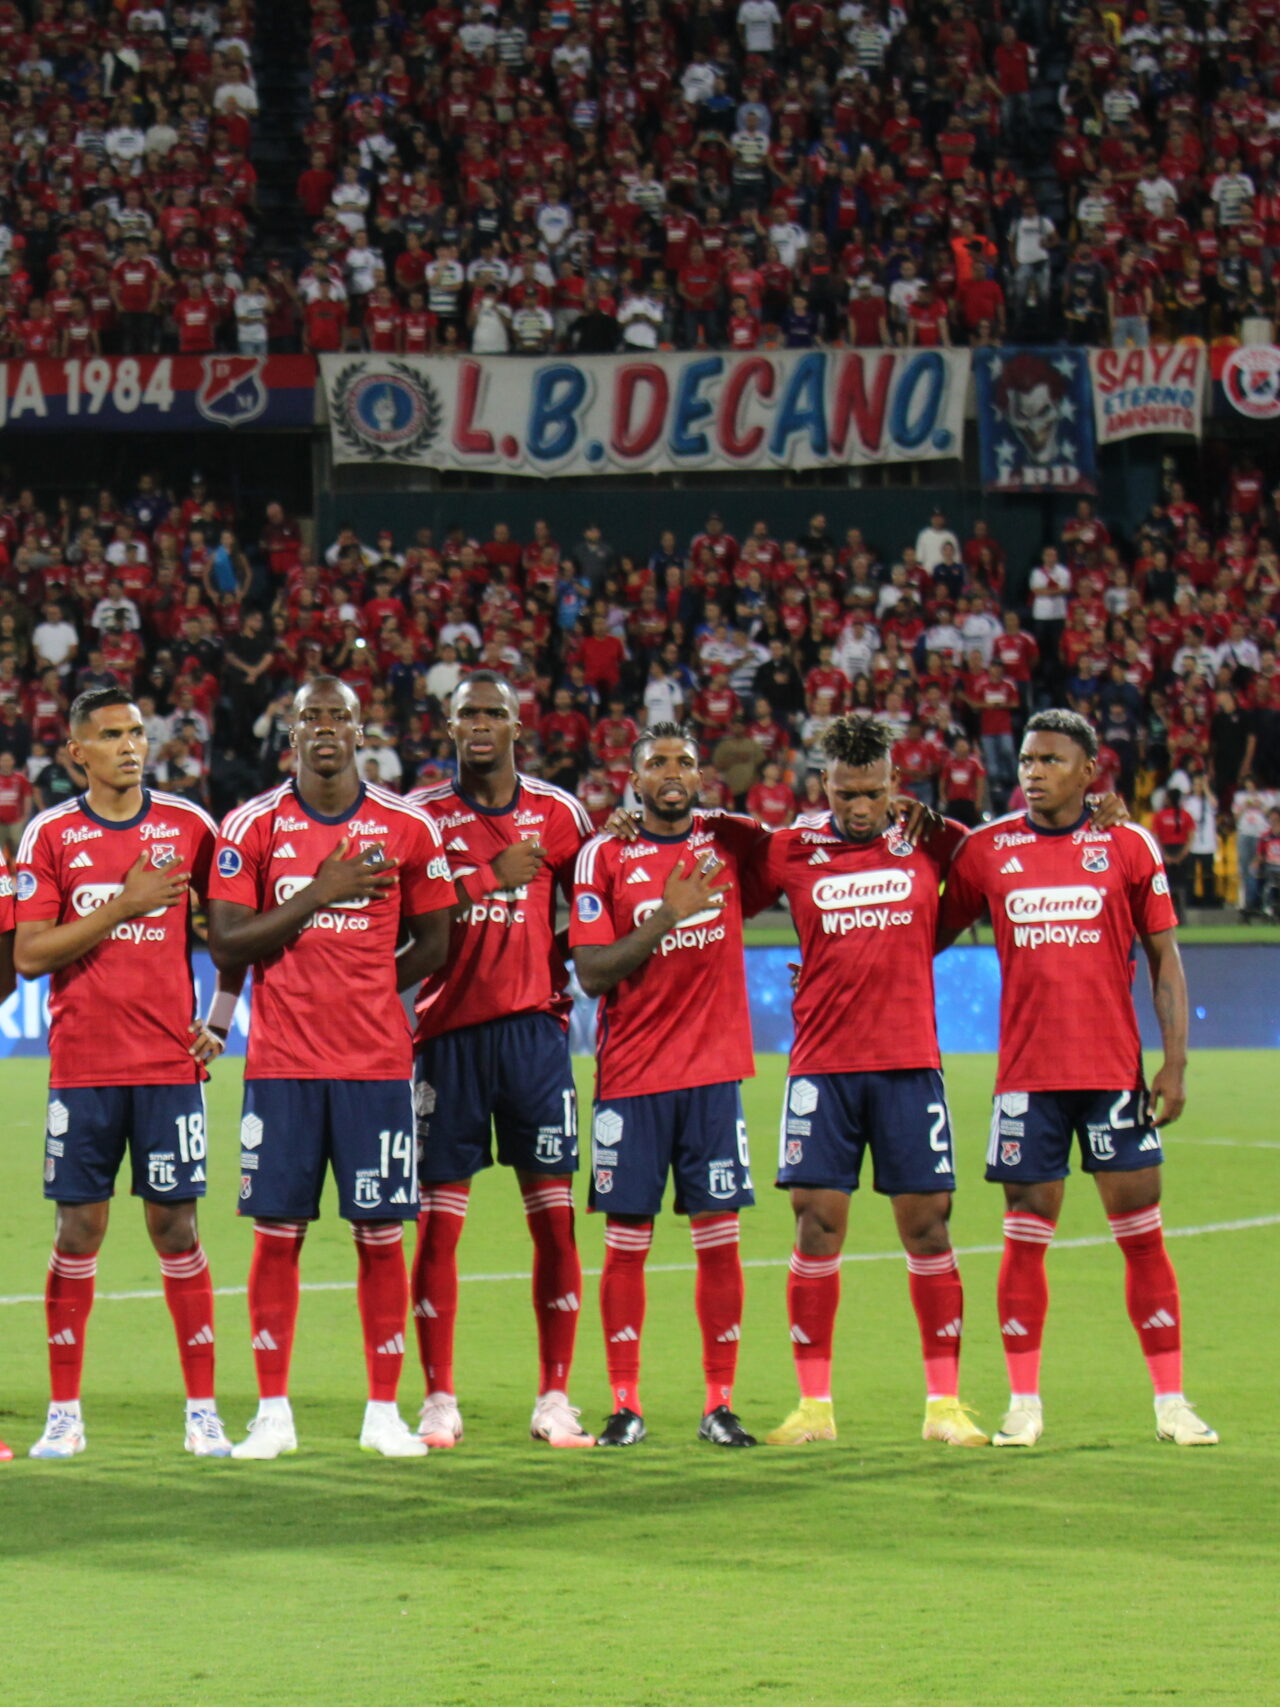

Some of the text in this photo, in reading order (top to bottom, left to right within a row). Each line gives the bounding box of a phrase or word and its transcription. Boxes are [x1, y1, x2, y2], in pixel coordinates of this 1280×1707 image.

[1096, 345, 1201, 393] SAYA
[63, 357, 175, 415] 1984
[1103, 386, 1195, 415] ETERNO
[61, 825, 103, 846] Pilsen
[140, 823, 181, 842] Pilsen
[273, 816, 308, 834] Pilsen
[348, 819, 389, 838] Pilsen
[619, 843, 659, 863] Pilsen
[994, 831, 1037, 851] Pilsen
[816, 879, 908, 903] Colanta
[1009, 896, 1099, 916] Colanta
[821, 907, 913, 936] Wplay.co
[654, 927, 725, 957] play.co
[1013, 922, 1101, 950] Wplay.co
[175, 1111, 206, 1164] 18
[926, 1102, 949, 1152] 2
[378, 1130, 412, 1178] 14
